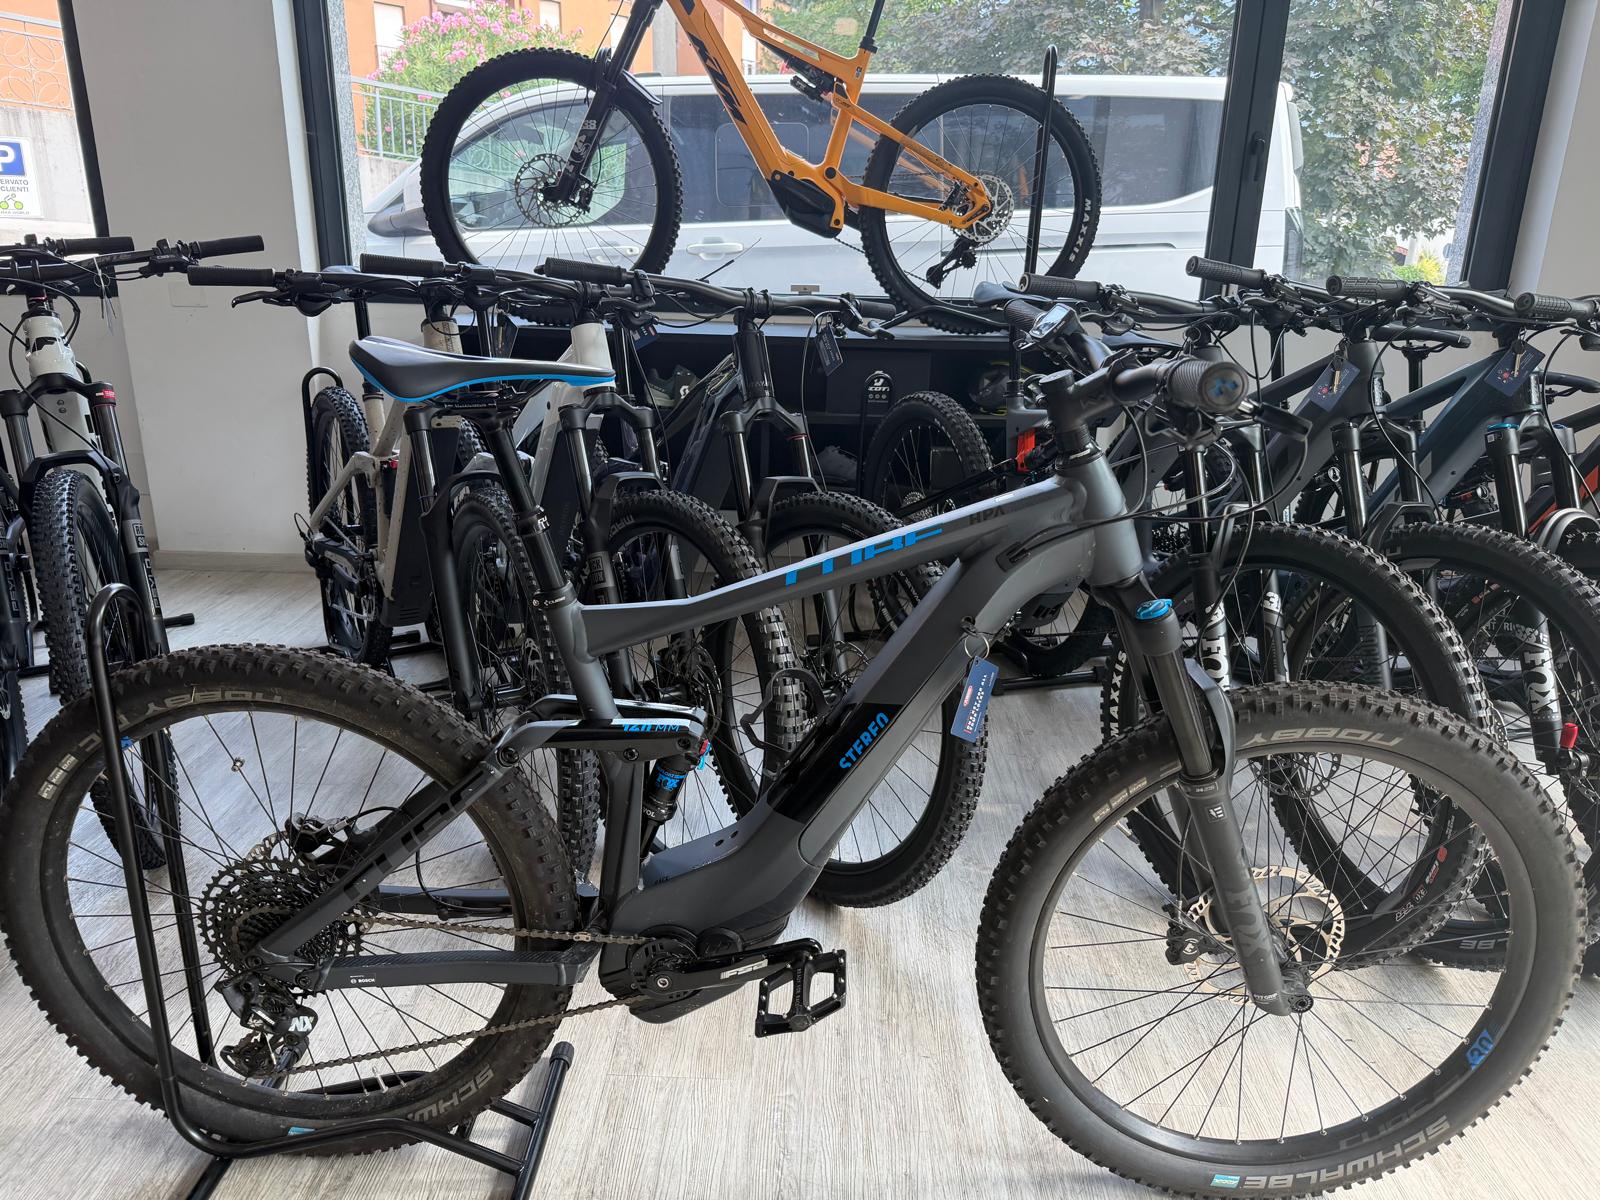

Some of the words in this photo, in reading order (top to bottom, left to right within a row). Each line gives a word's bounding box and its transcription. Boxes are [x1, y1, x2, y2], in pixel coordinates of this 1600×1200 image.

[1069, 198, 1091, 262] MAXXIS
[1110, 651, 1126, 737] MAXXIS
[1522, 648, 1560, 715] FOX
[1241, 727, 1403, 747] NOBBY
[288, 1016, 314, 1031] NX
[1243, 1115, 1450, 1189] SCHWALBE
